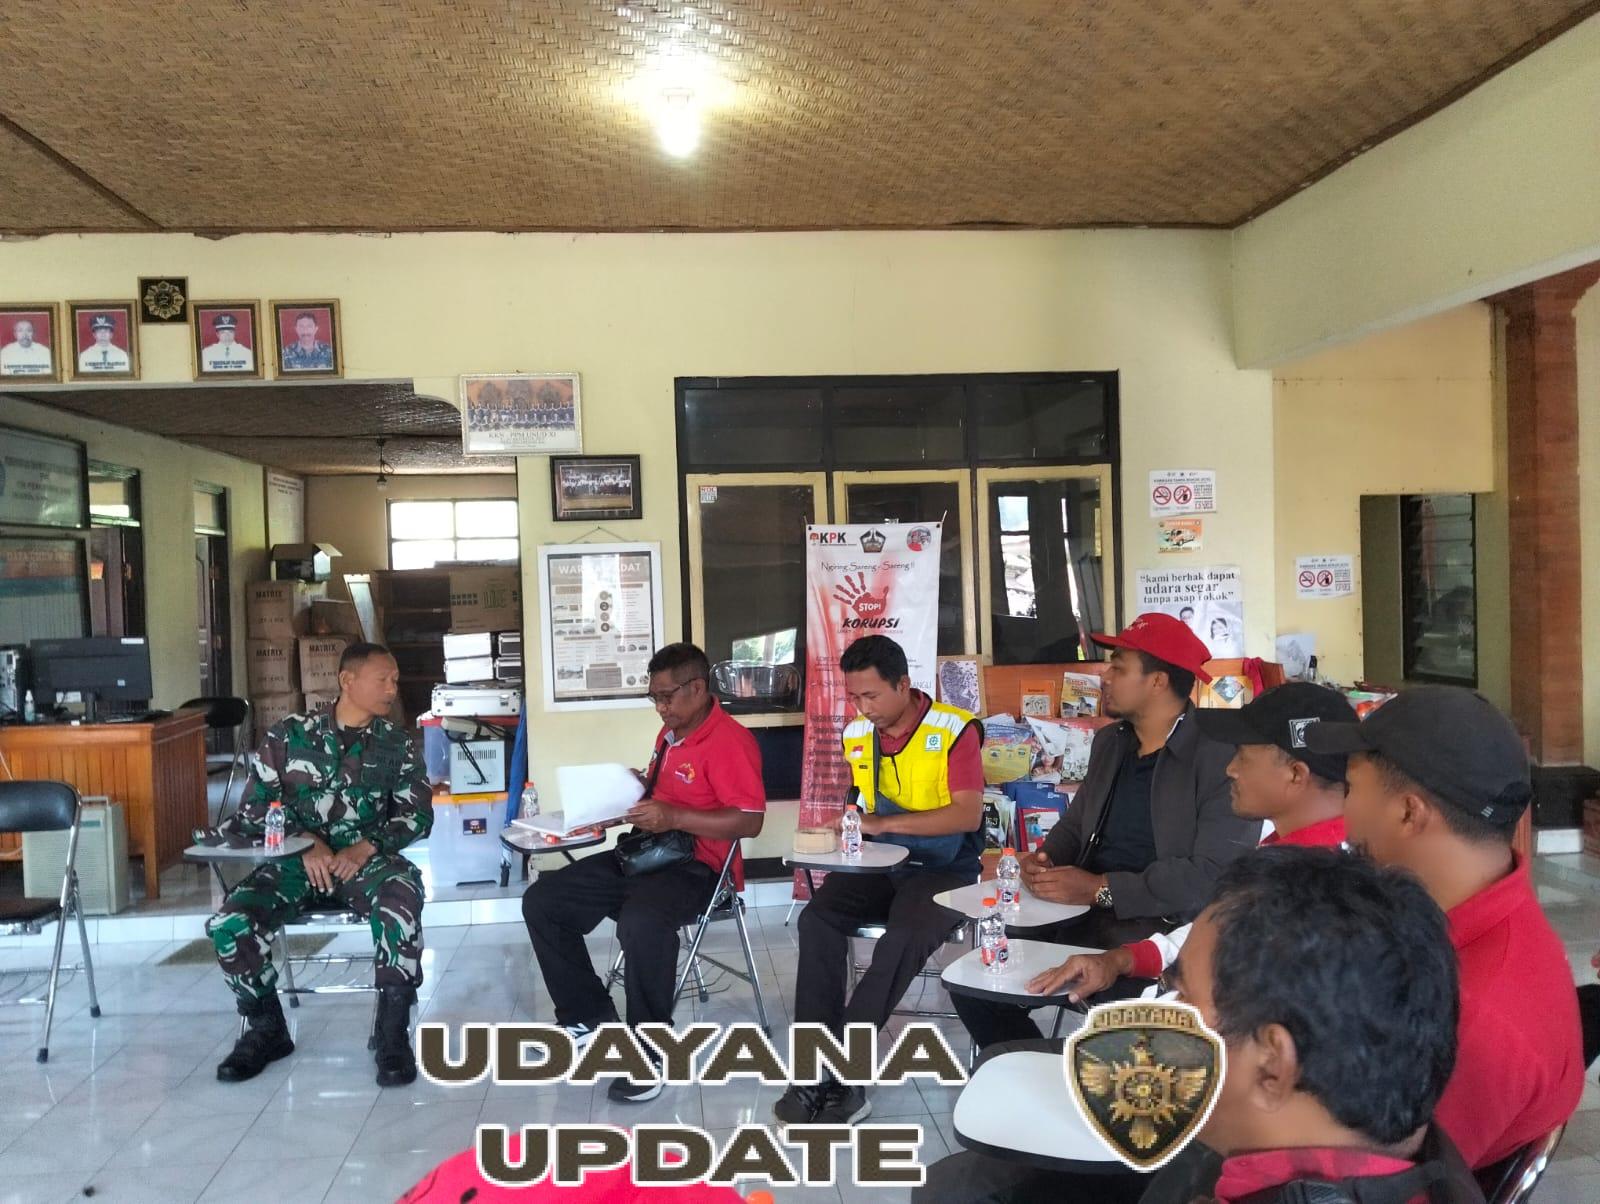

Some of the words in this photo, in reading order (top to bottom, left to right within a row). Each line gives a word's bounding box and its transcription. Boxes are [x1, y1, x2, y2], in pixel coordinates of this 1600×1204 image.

[820, 532, 846, 544] KPK
[1172, 572, 1204, 582] berhak
[1207, 571, 1236, 582] dapat
[1144, 583, 1182, 594] udara
[1185, 583, 1219, 593] segar
[256, 591, 283, 599] MATRIX
[1143, 595, 1171, 605] tanpa
[1173, 594, 1196, 604] asap
[858, 602, 881, 612] STOP!
[842, 617, 900, 629] KORUPSI
[256, 648, 283, 657] MATRIX
[309, 644, 337, 653] MATRIX
